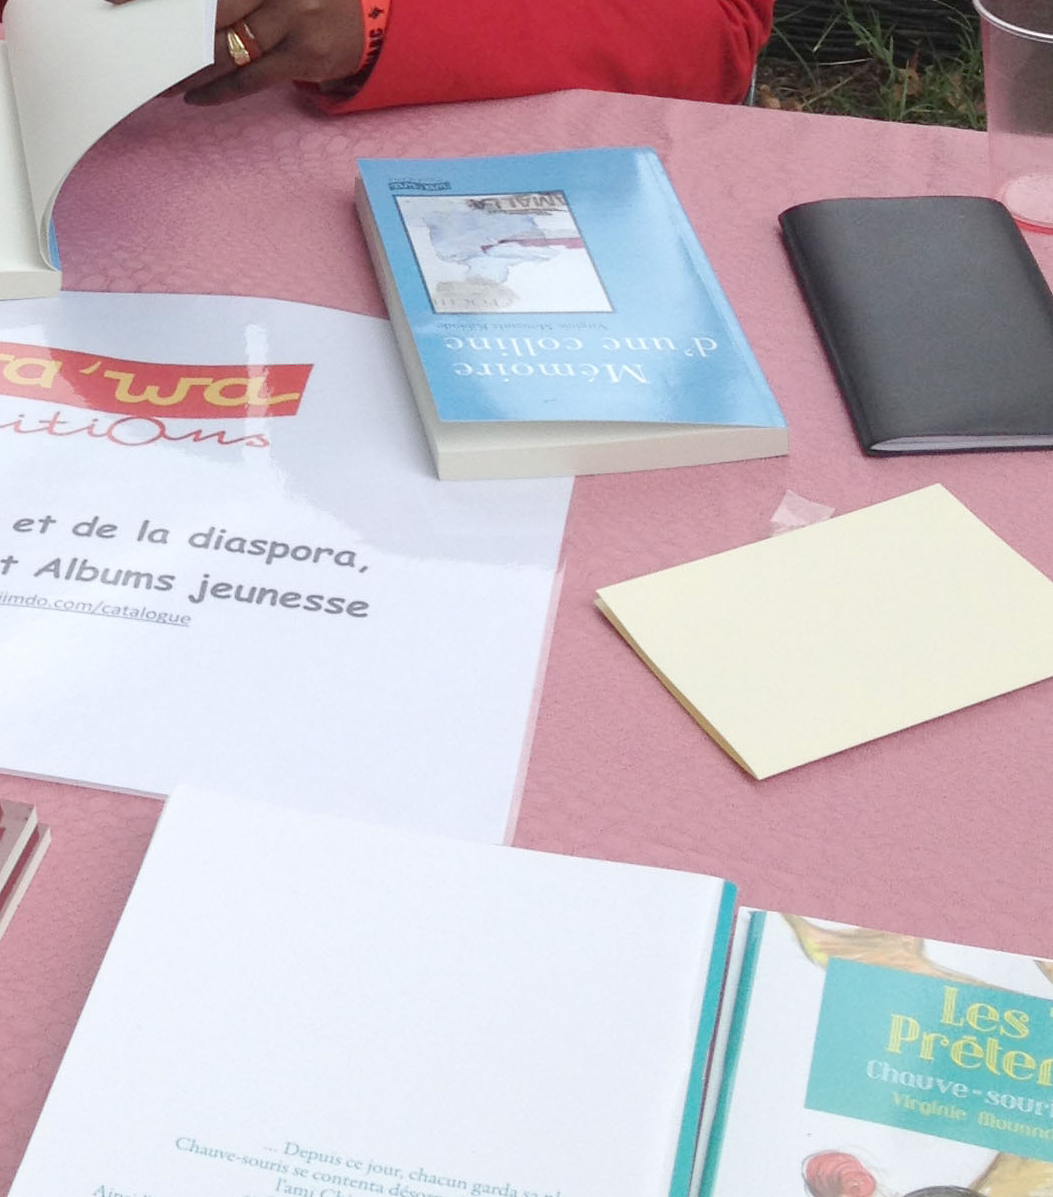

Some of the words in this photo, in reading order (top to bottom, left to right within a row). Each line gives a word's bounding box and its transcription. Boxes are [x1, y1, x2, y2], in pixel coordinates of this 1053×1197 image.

[444, 336, 585, 357] colline
[452, 360, 650, 385] Mémoire
[602, 336, 719, 358] d'une
[12, 515, 57, 534] et
[72, 516, 118, 539] de
[137, 519, 169, 545] la
[188, 526, 369, 573] diaspora,
[34, 557, 176, 592] Albums
[187, 573, 370, 619] jeunesse
[940, 985, 1031, 1039] Les
[175, 1136, 289, 1174] Chauve-souris
[294, 1165, 309, 1178] se
[312, 1171, 384, 1194] contenta
[284, 1141, 342, 1166] Depuis
[346, 1159, 363, 1170] ce
[363, 1158, 404, 1180] jour,
[408, 1167, 468, 1191] chacun
[470, 1181, 518, 1197] garda
